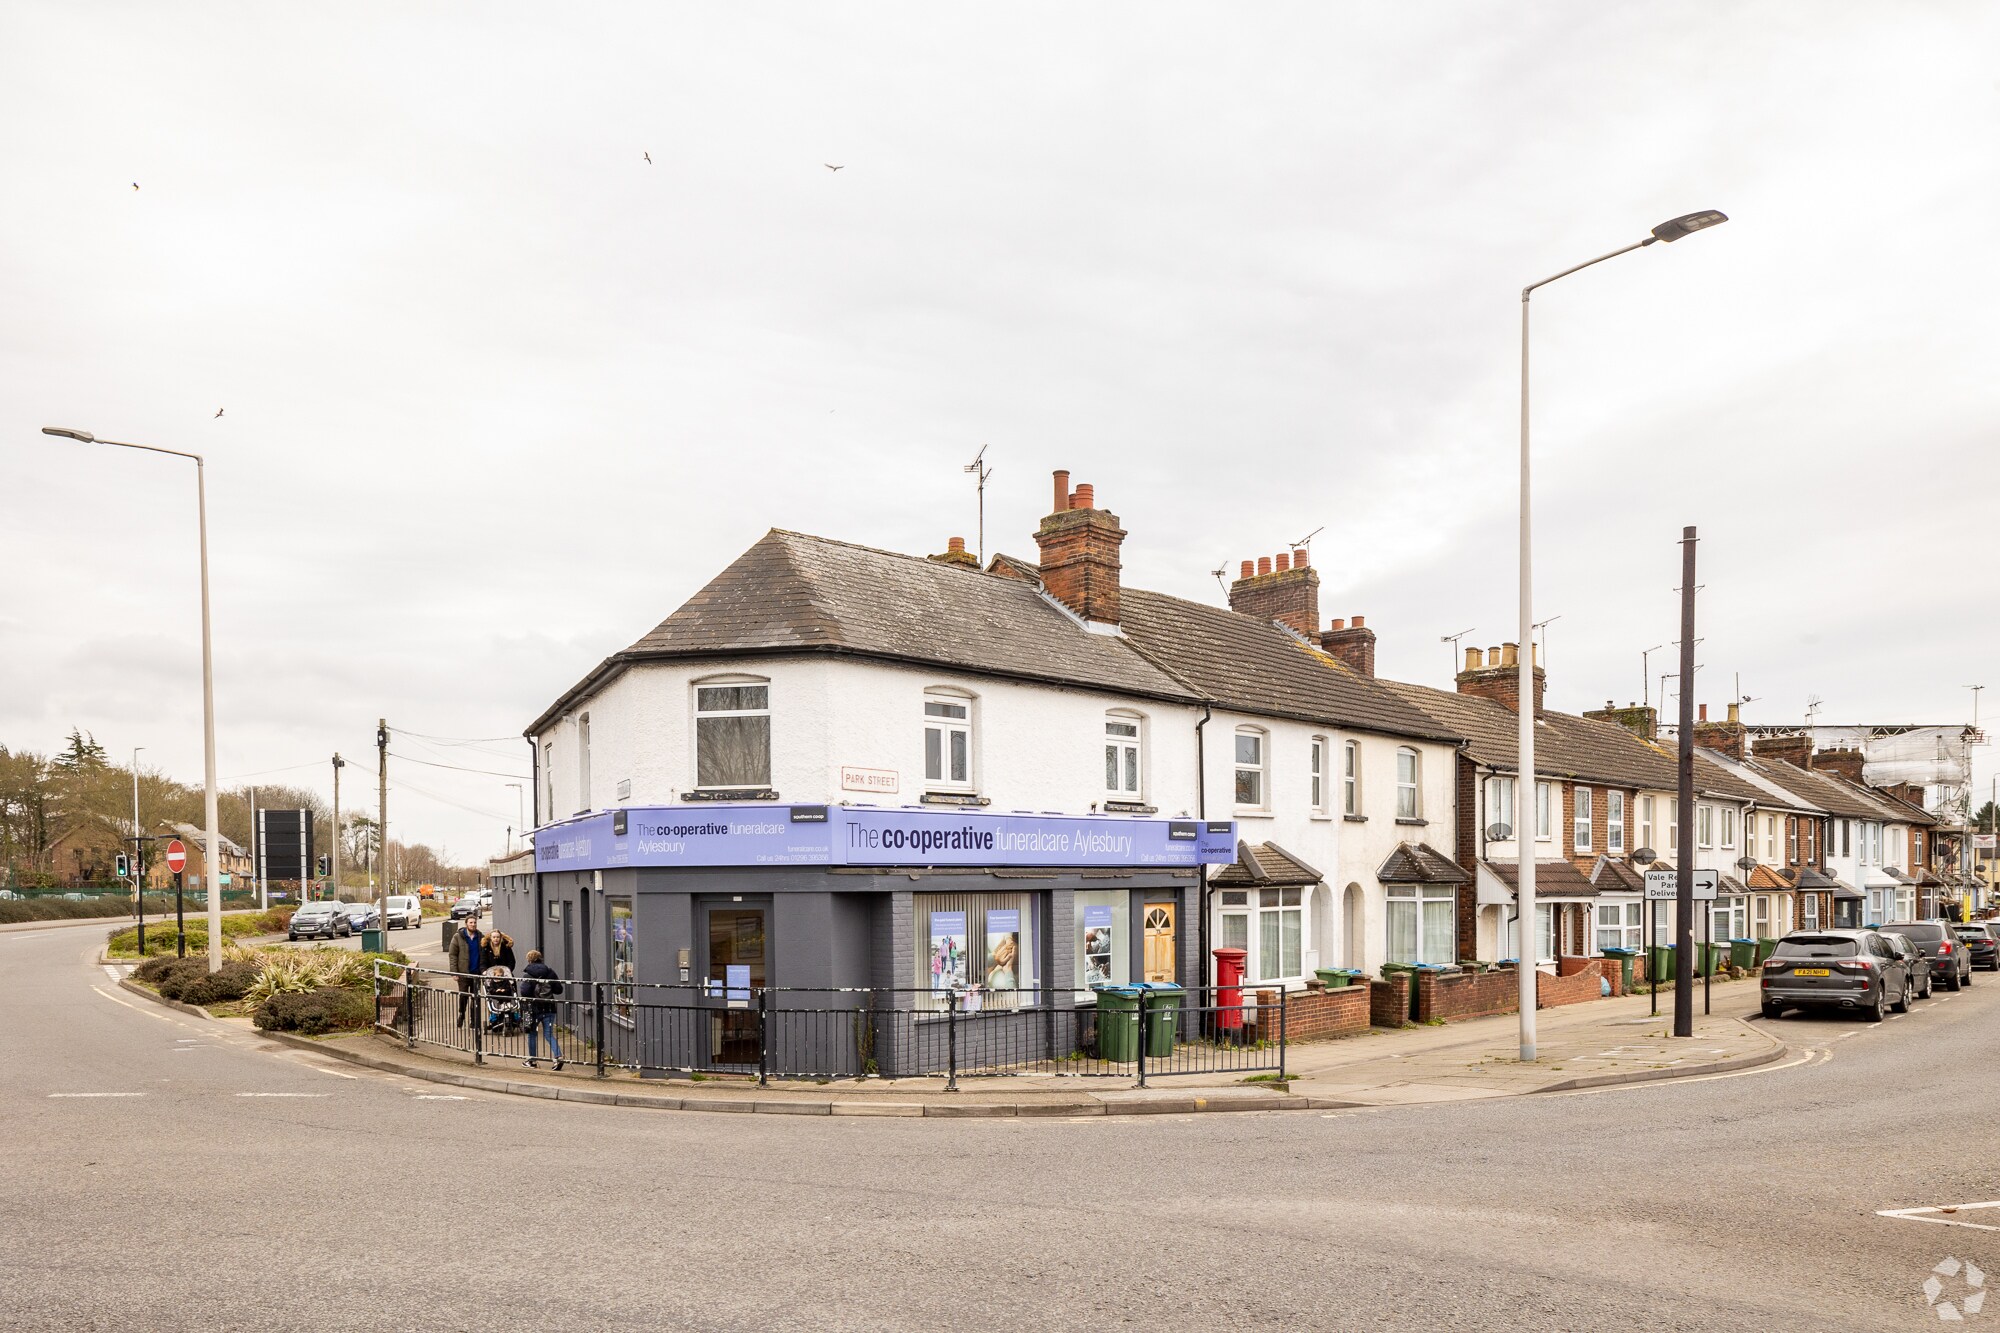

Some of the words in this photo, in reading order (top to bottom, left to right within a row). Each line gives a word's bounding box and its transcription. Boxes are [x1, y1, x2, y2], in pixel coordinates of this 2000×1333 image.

[845, 773, 865, 784] PARK
[868, 775, 895, 787] STREET
[637, 823, 656, 836] The
[729, 821, 785, 835] funeralcare
[637, 839, 686, 855] Aylesbury
[846, 822, 879, 848] The
[995, 826, 1069, 852] funeralcare
[1073, 829, 1132, 858] Aylesbury
